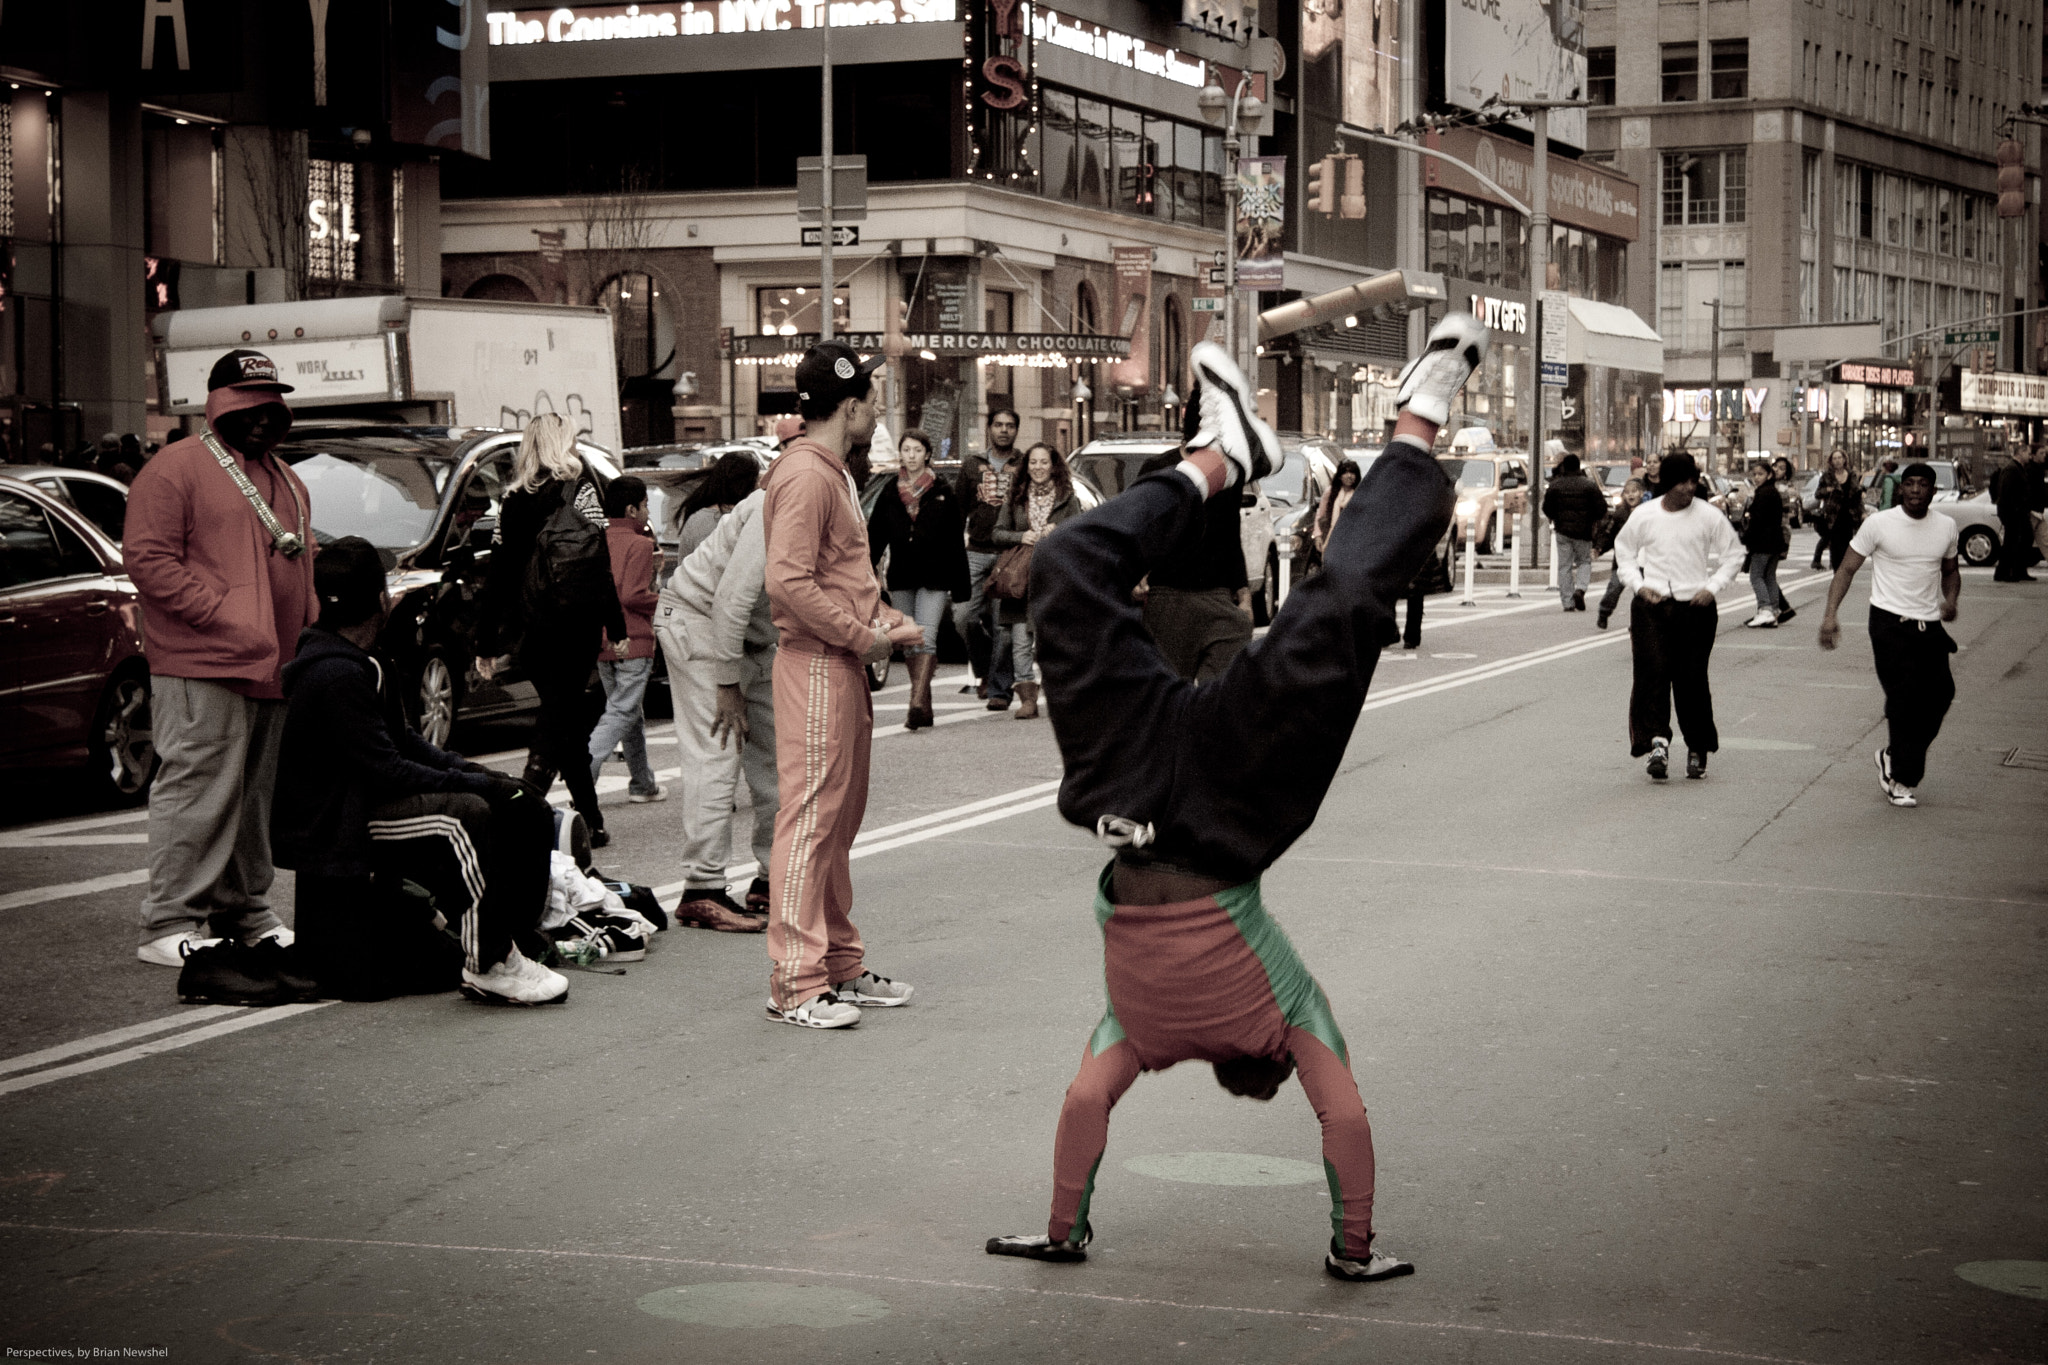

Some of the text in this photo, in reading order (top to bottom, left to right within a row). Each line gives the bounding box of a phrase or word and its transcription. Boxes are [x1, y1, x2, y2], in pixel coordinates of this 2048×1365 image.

[487, 12, 545, 45] The
[548, 5, 677, 42] Cousins
[681, 2, 714, 35] in
[1498, 156, 1523, 190] new
[1551, 172, 1585, 210] sports
[1586, 177, 1613, 218] clubs
[1501, 300, 1526, 334] GIFTS
[783, 335, 813, 349] THE
[911, 335, 1007, 349] MERICAN
[1017, 336, 1108, 351] CHOCOLATE
[1964, 334, 1977, 342] 49
[296, 360, 327, 375] WORK
[1892, 368, 1914, 386] PLAYERS
[1978, 378, 2015, 397] COMPUTER
[2025, 383, 2046, 400] VIDEO
